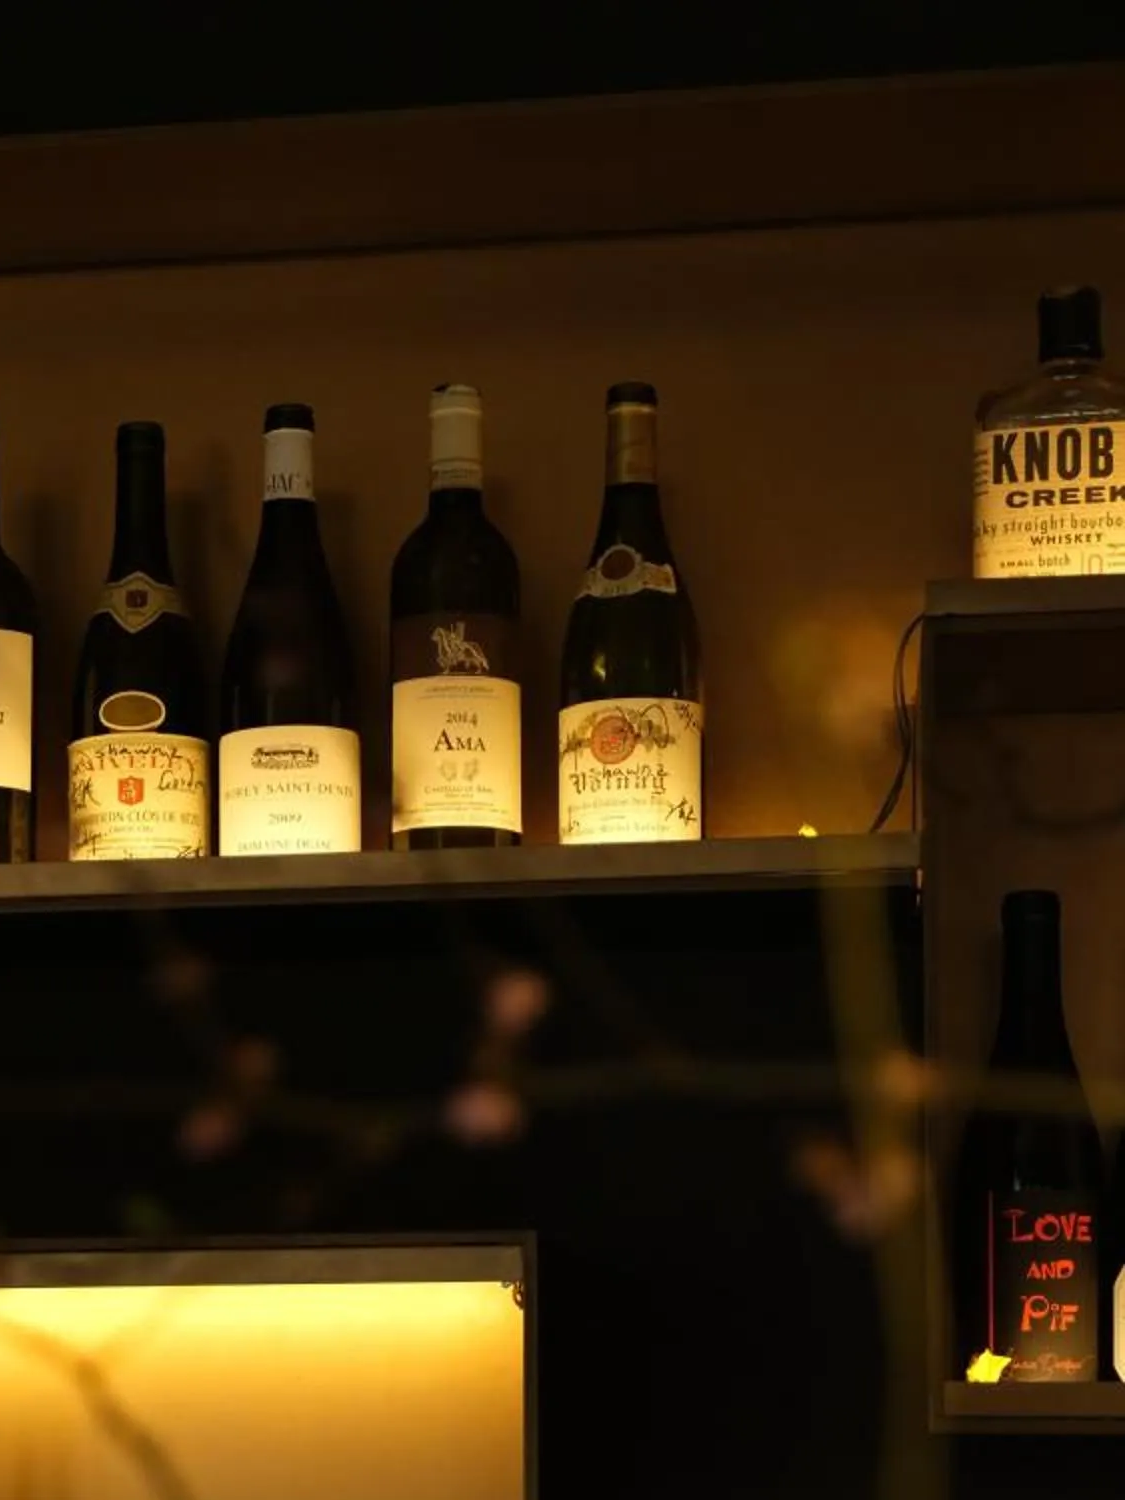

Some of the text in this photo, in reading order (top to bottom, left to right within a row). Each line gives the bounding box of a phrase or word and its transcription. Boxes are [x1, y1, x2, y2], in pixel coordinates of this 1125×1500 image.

[992, 426, 1114, 485] KNOB
[1005, 485, 1125, 509] CREEK
[1003, 514, 1066, 535] straight
[1030, 533, 1104, 546] WHISKEY
[1002, 1208, 1092, 1242] LOVE
[1026, 1259, 1075, 1280] AND
